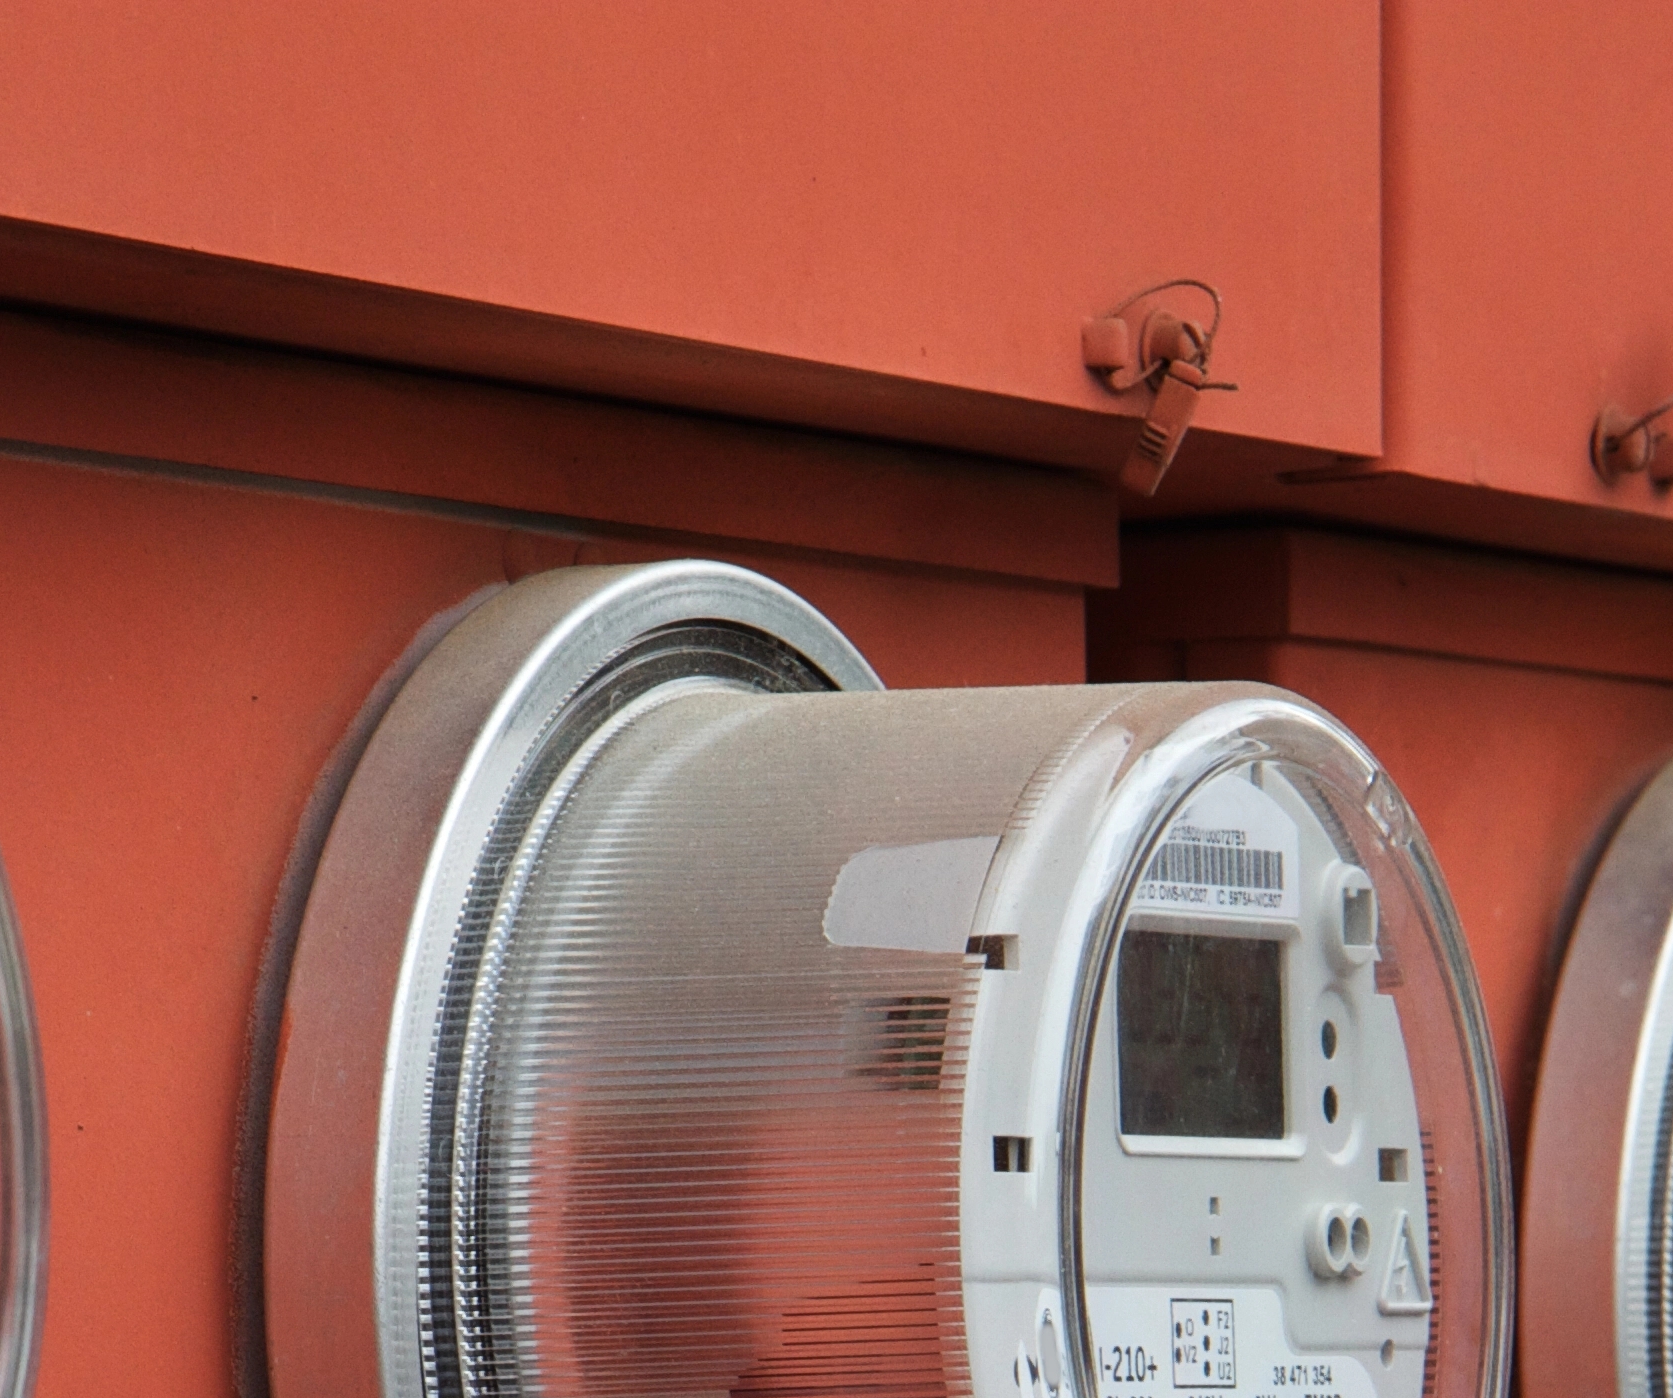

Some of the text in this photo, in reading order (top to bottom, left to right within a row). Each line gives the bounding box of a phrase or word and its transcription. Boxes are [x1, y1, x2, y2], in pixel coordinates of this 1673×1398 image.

[1216, 1310, 1230, 1330] F2
[1183, 1345, 1198, 1364] V2
[1217, 1336, 1231, 1356] J2
[1098, 1345, 1158, 1383] I-210+
[1217, 1361, 1233, 1381] U2
[1272, 1364, 1333, 1386] 38 471 354
